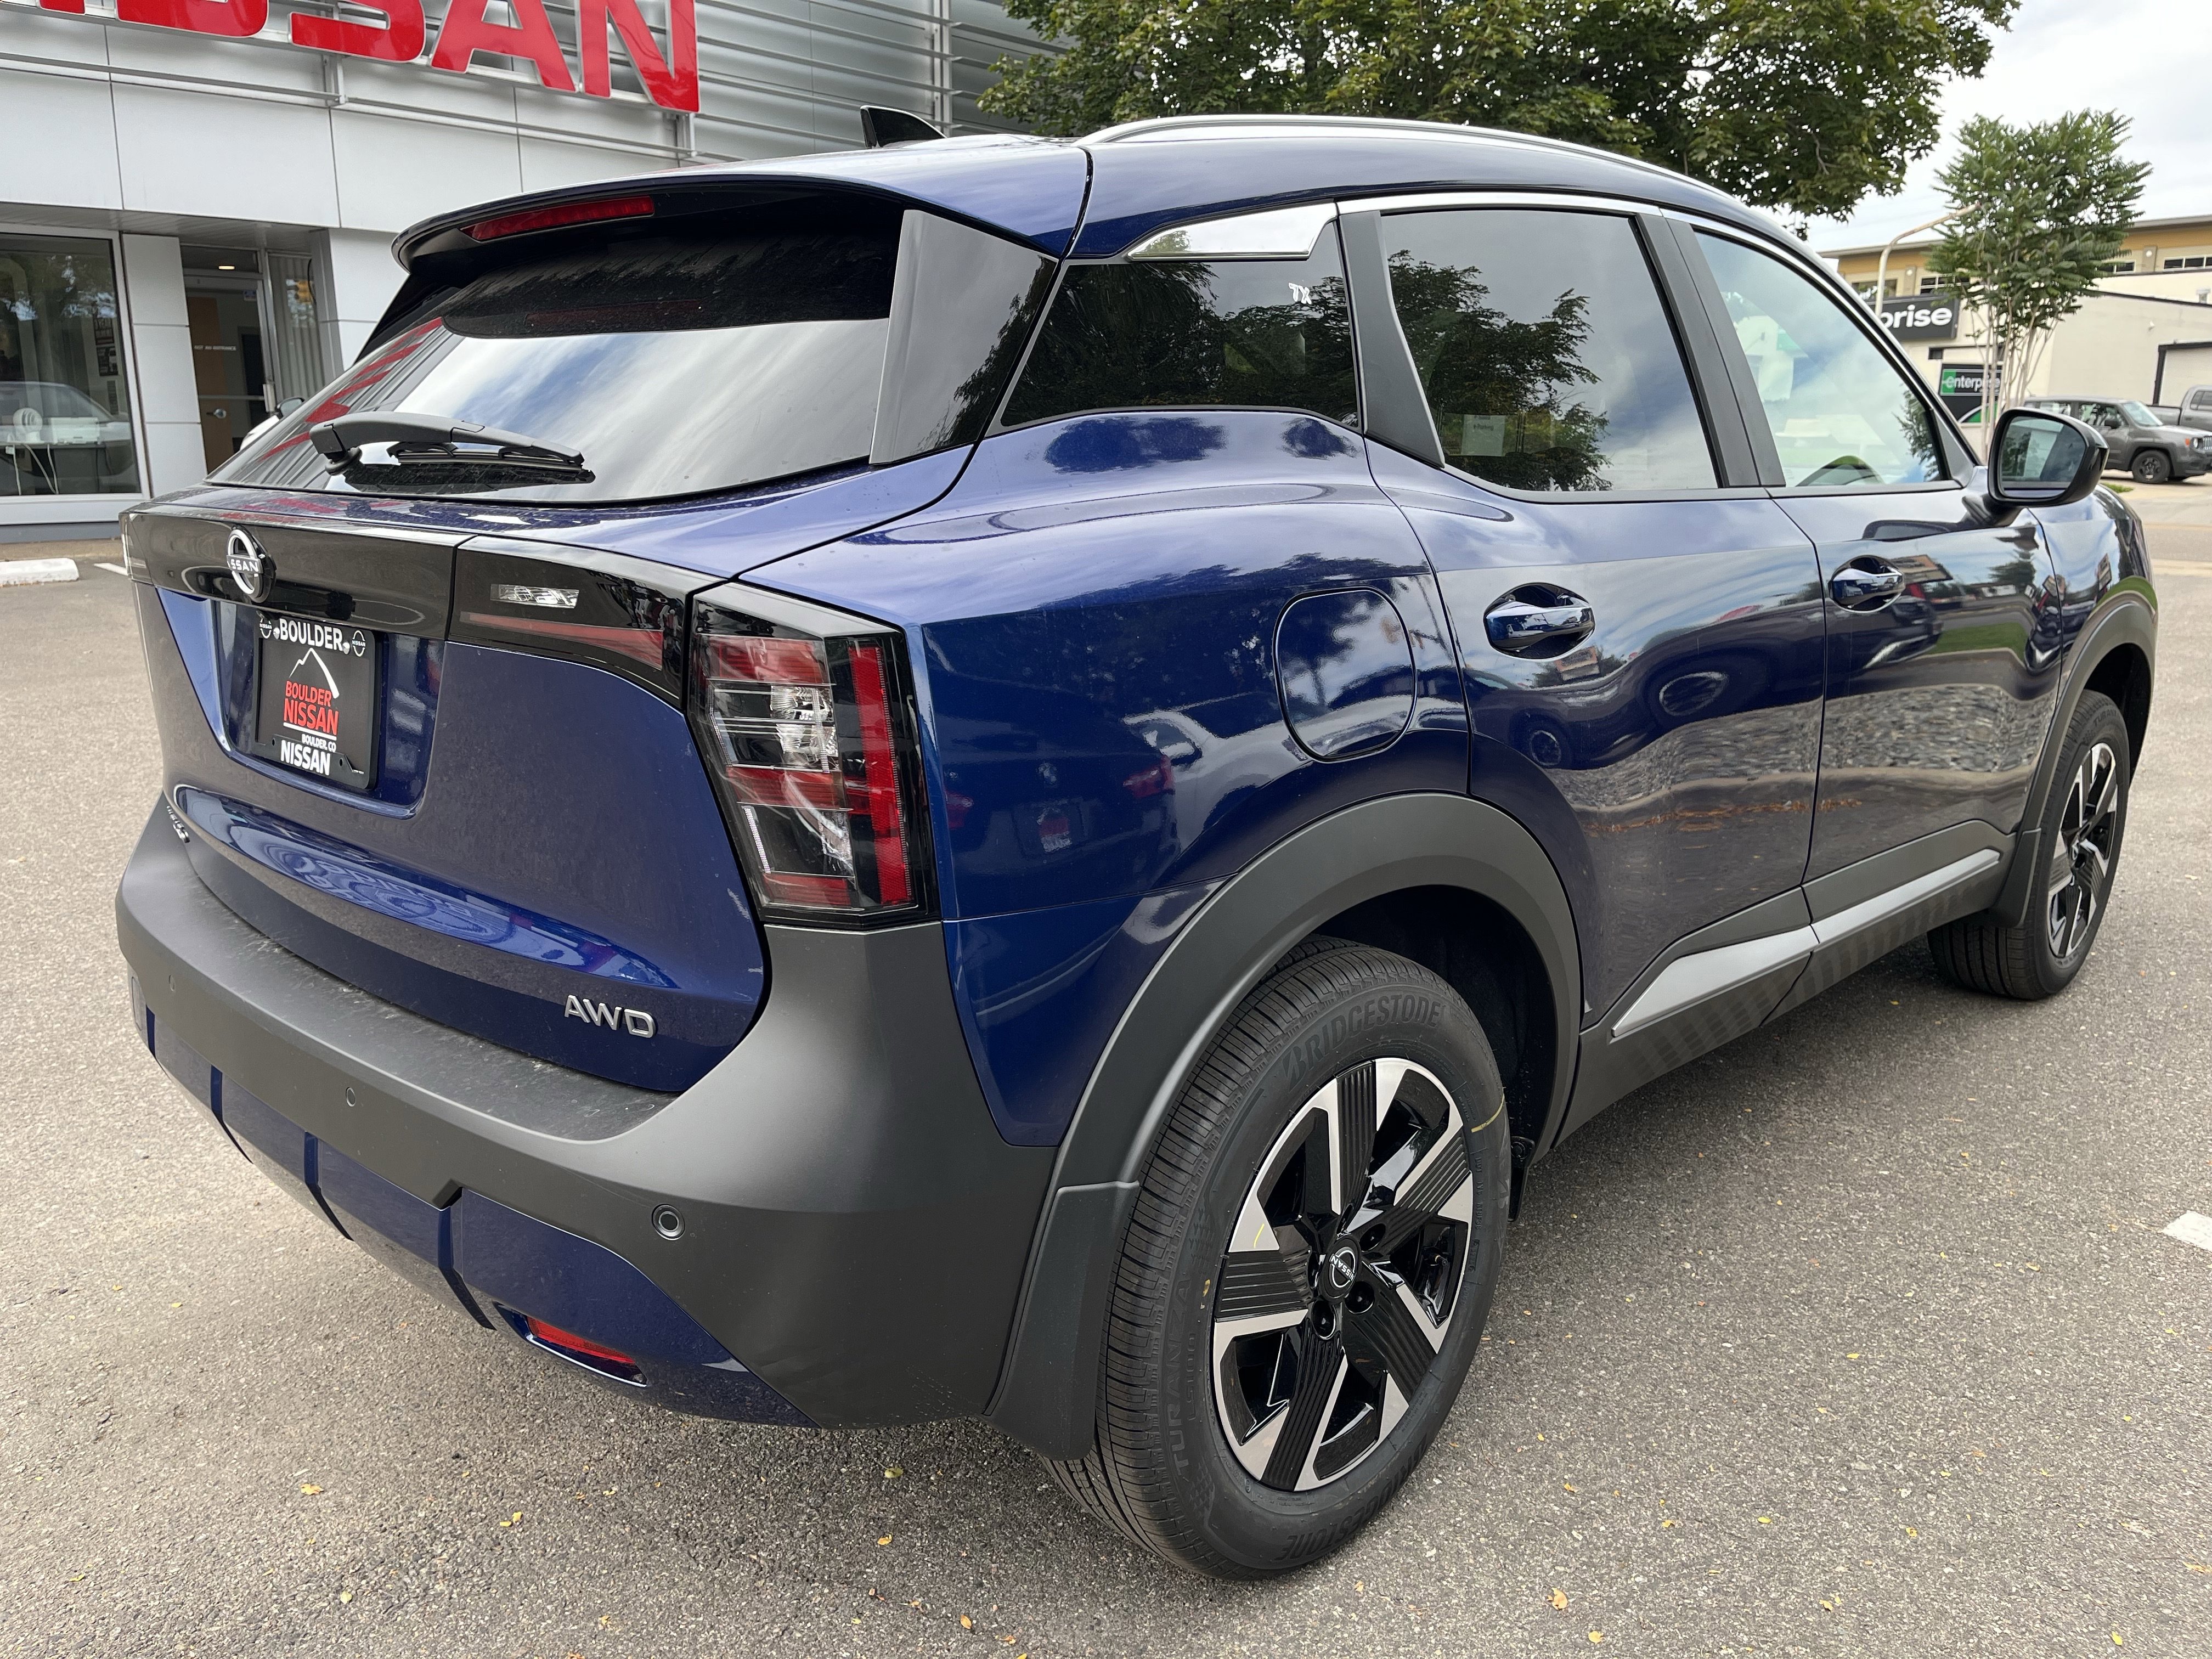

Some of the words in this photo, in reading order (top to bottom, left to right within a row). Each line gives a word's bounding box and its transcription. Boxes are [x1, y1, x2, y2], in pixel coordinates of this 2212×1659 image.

[279, 618, 343, 652] BOULDER
[285, 680, 332, 707] BOULDER
[283, 698, 339, 736] NISSAN
[280, 740, 331, 776] NISSAN
[564, 994, 657, 1039] AWD
[1281, 994, 1446, 1094] BRIDGESTONE
[1330, 1254, 1355, 1281] NISSAN
[1166, 1278, 1191, 1476] TURANZA
